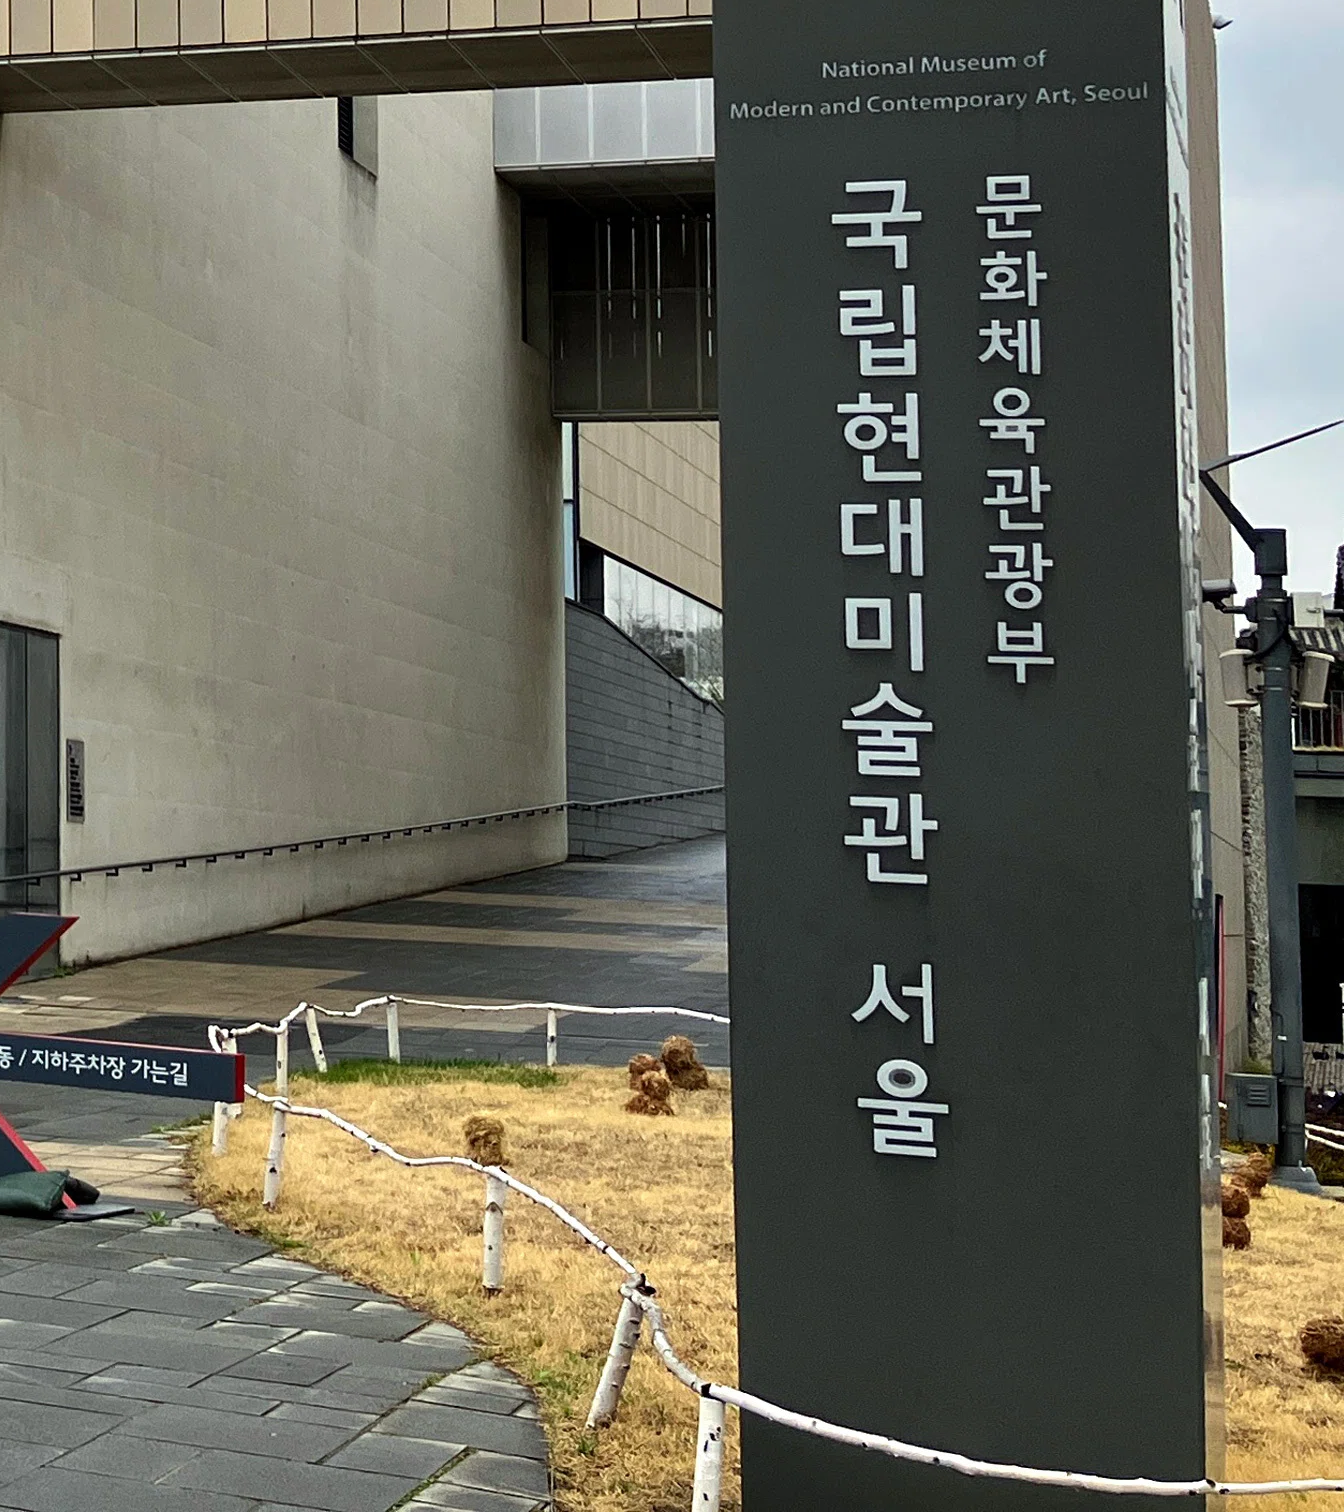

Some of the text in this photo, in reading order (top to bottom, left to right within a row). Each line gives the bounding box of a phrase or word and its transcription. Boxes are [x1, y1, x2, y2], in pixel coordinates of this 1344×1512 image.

[822, 48, 1047, 79] National Museum of
[729, 82, 1148, 120] Modern and Contemporary Art, Seoul
[975, 174, 1055, 684] 문화체육관광부
[831, 179, 950, 1158] 국립현대미술관 서울
[31, 1048, 126, 1078] 지하주차장
[130, 1059, 188, 1087] 가는길
